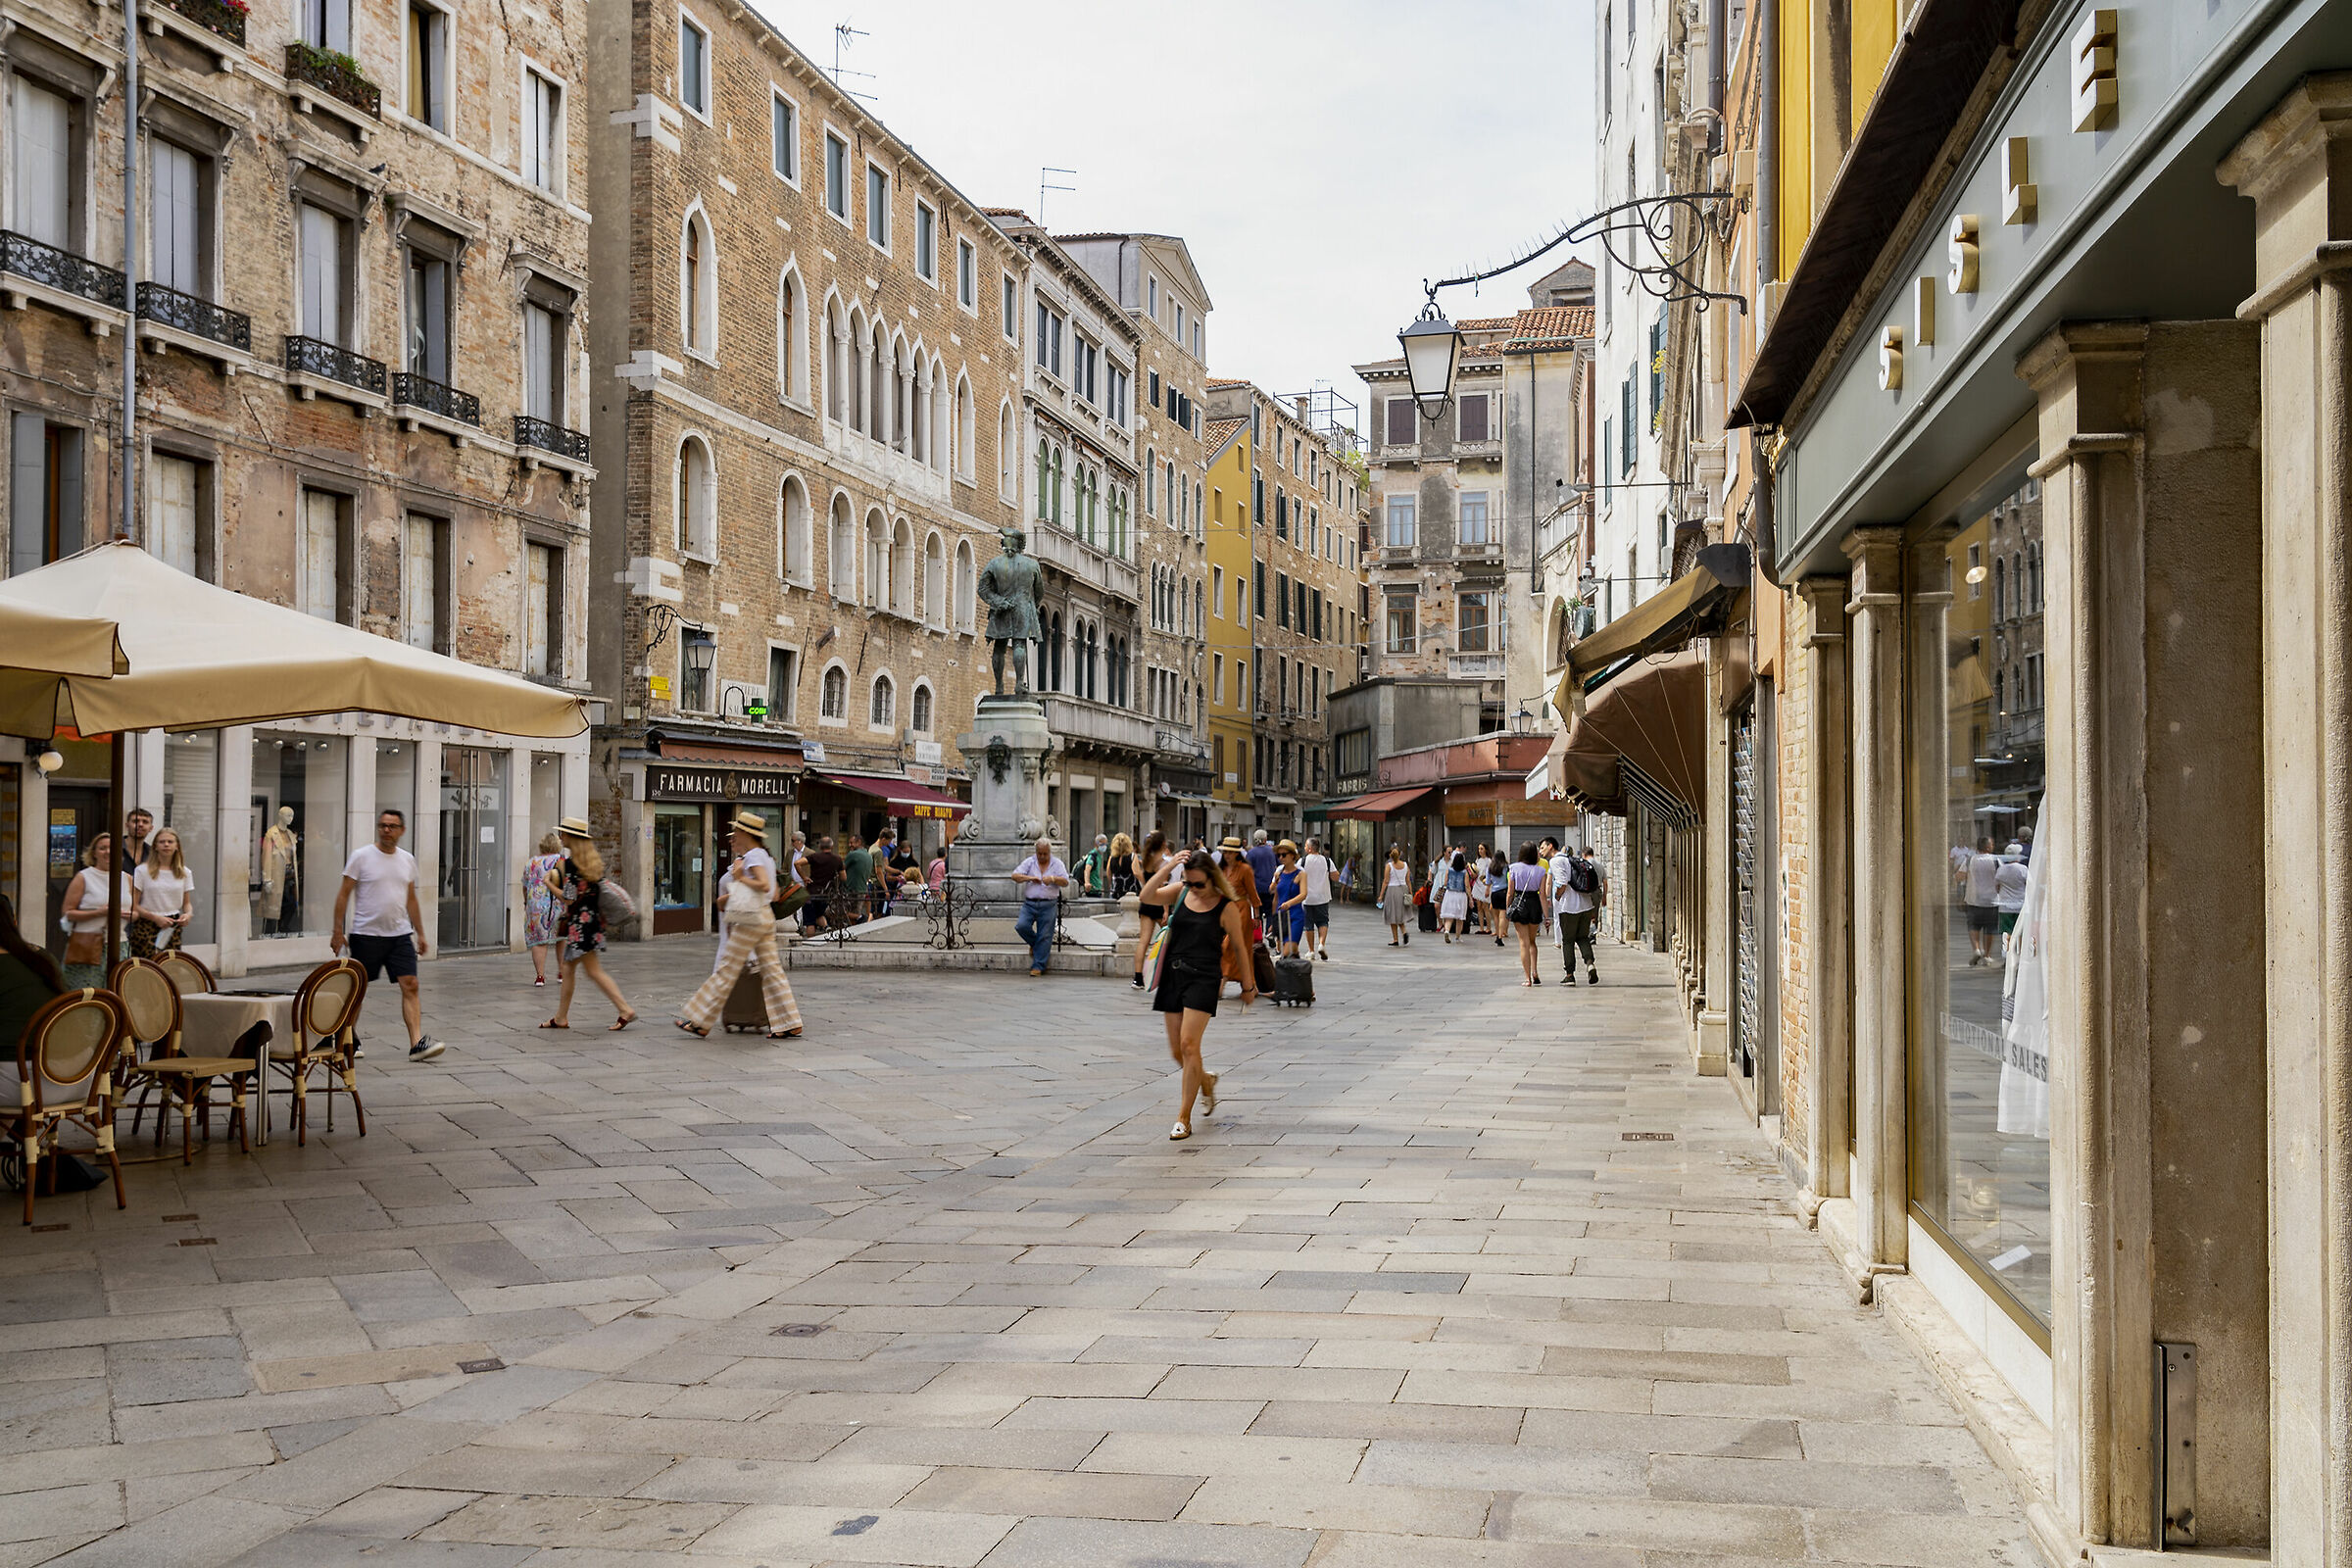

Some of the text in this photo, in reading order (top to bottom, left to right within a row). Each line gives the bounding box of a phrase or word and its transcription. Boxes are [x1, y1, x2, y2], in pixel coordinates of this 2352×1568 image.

[660, 774, 790, 795] FARMACIA MORELLI
[1337, 778, 1367, 794] FABRIS
[934, 807, 953, 818] RIALTO
[2012, 1043, 2047, 1082] SALES
